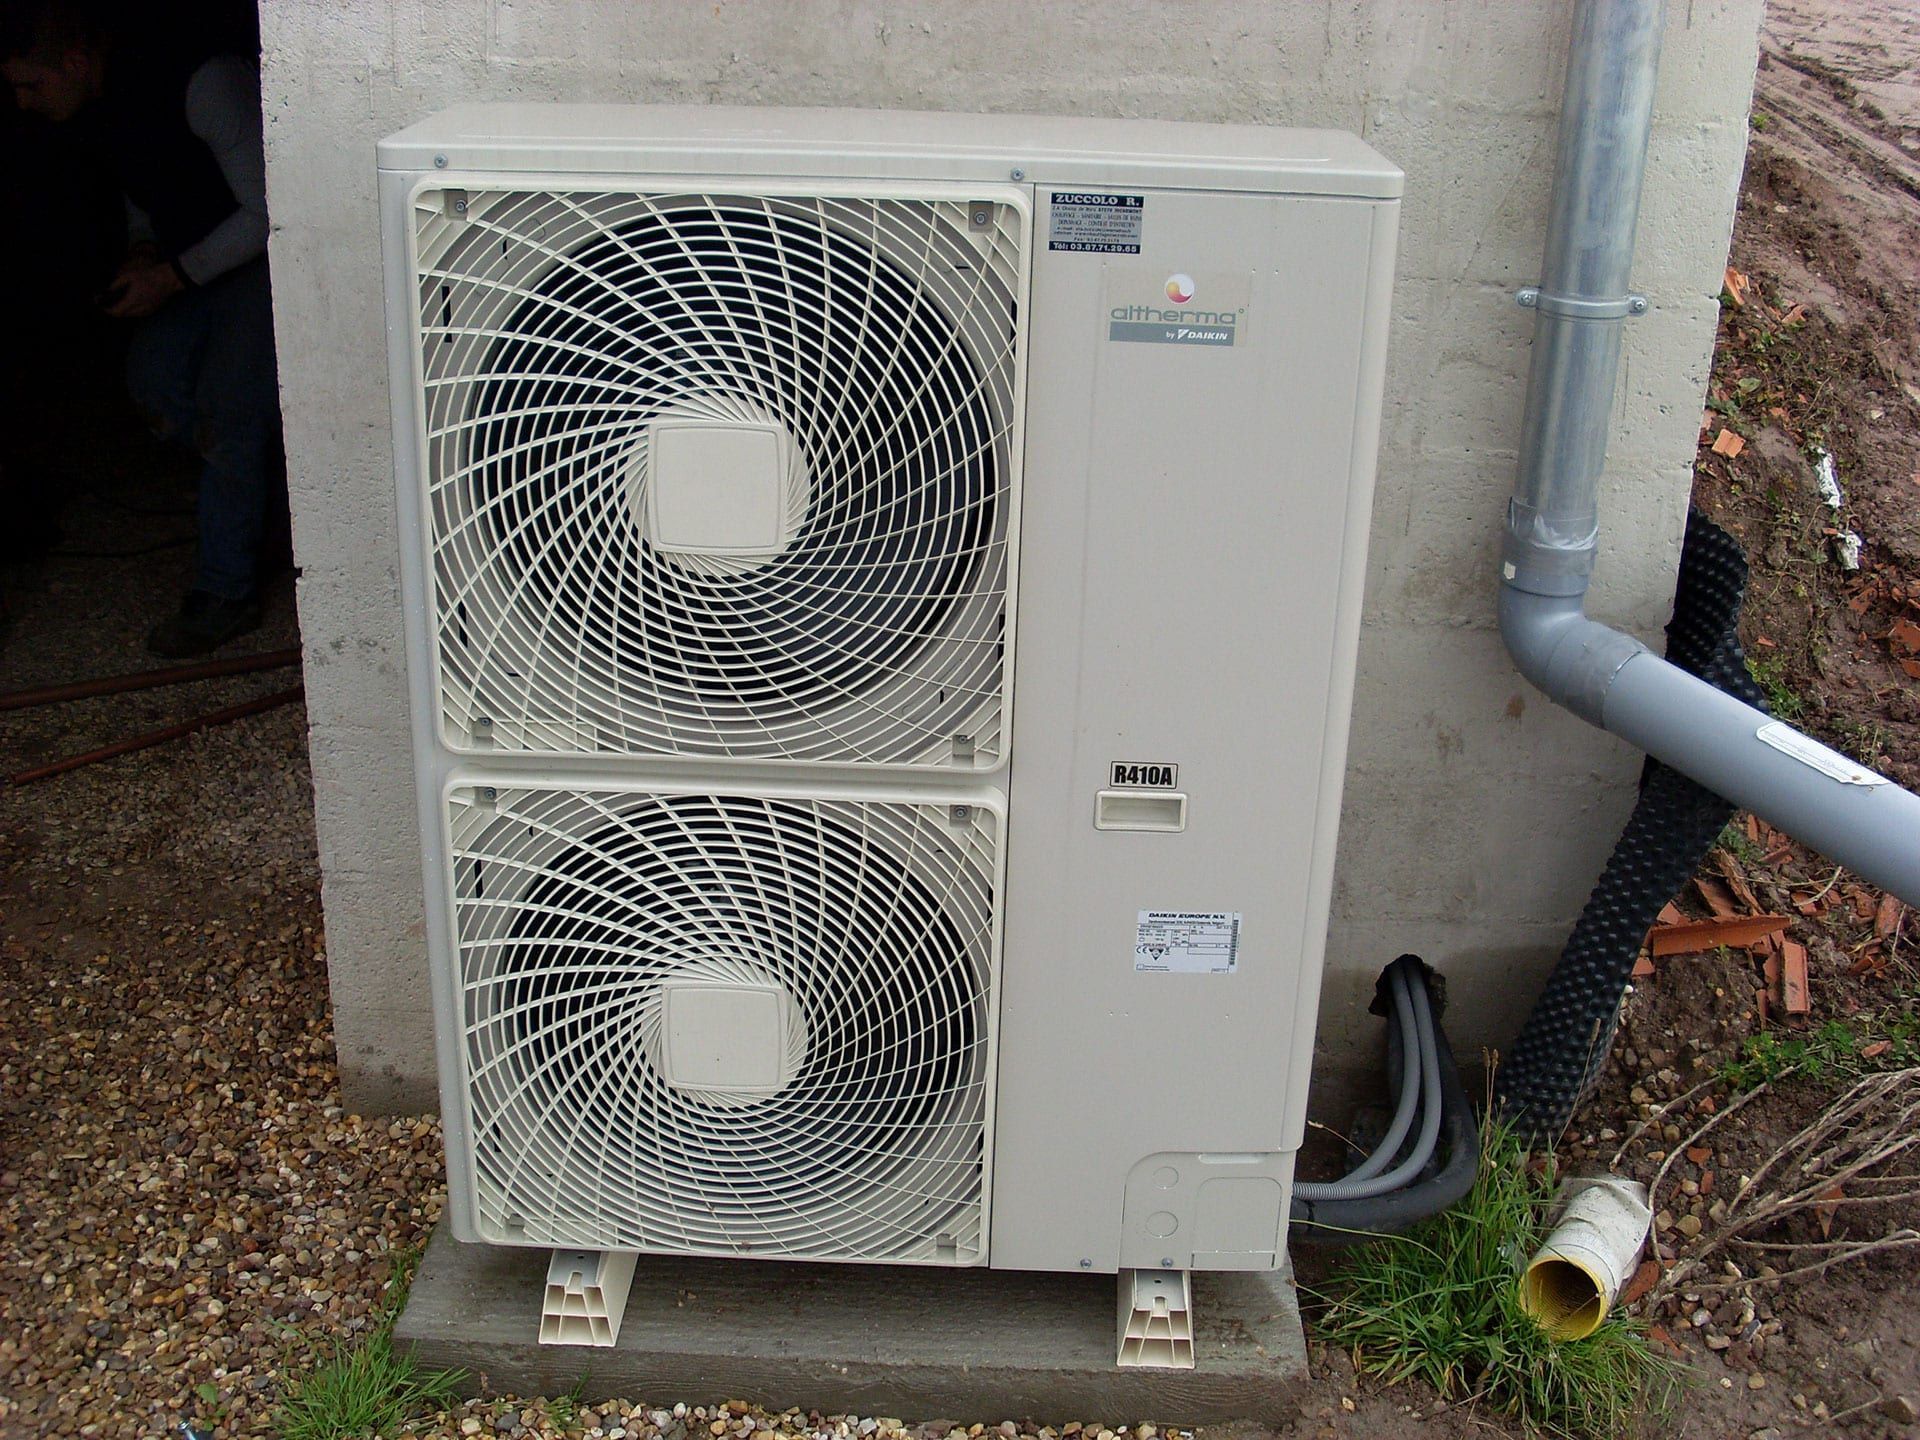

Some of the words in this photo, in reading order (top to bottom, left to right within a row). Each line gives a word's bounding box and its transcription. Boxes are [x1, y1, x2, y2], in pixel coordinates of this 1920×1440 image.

[1055, 194, 1118, 205] ZUCCOLO
[1126, 197, 1140, 206] R.
[1110, 305, 1236, 325] altherma
[1165, 331, 1175, 339] by
[1187, 331, 1228, 340] DAIKIN
[1114, 765, 1173, 785] R410A
